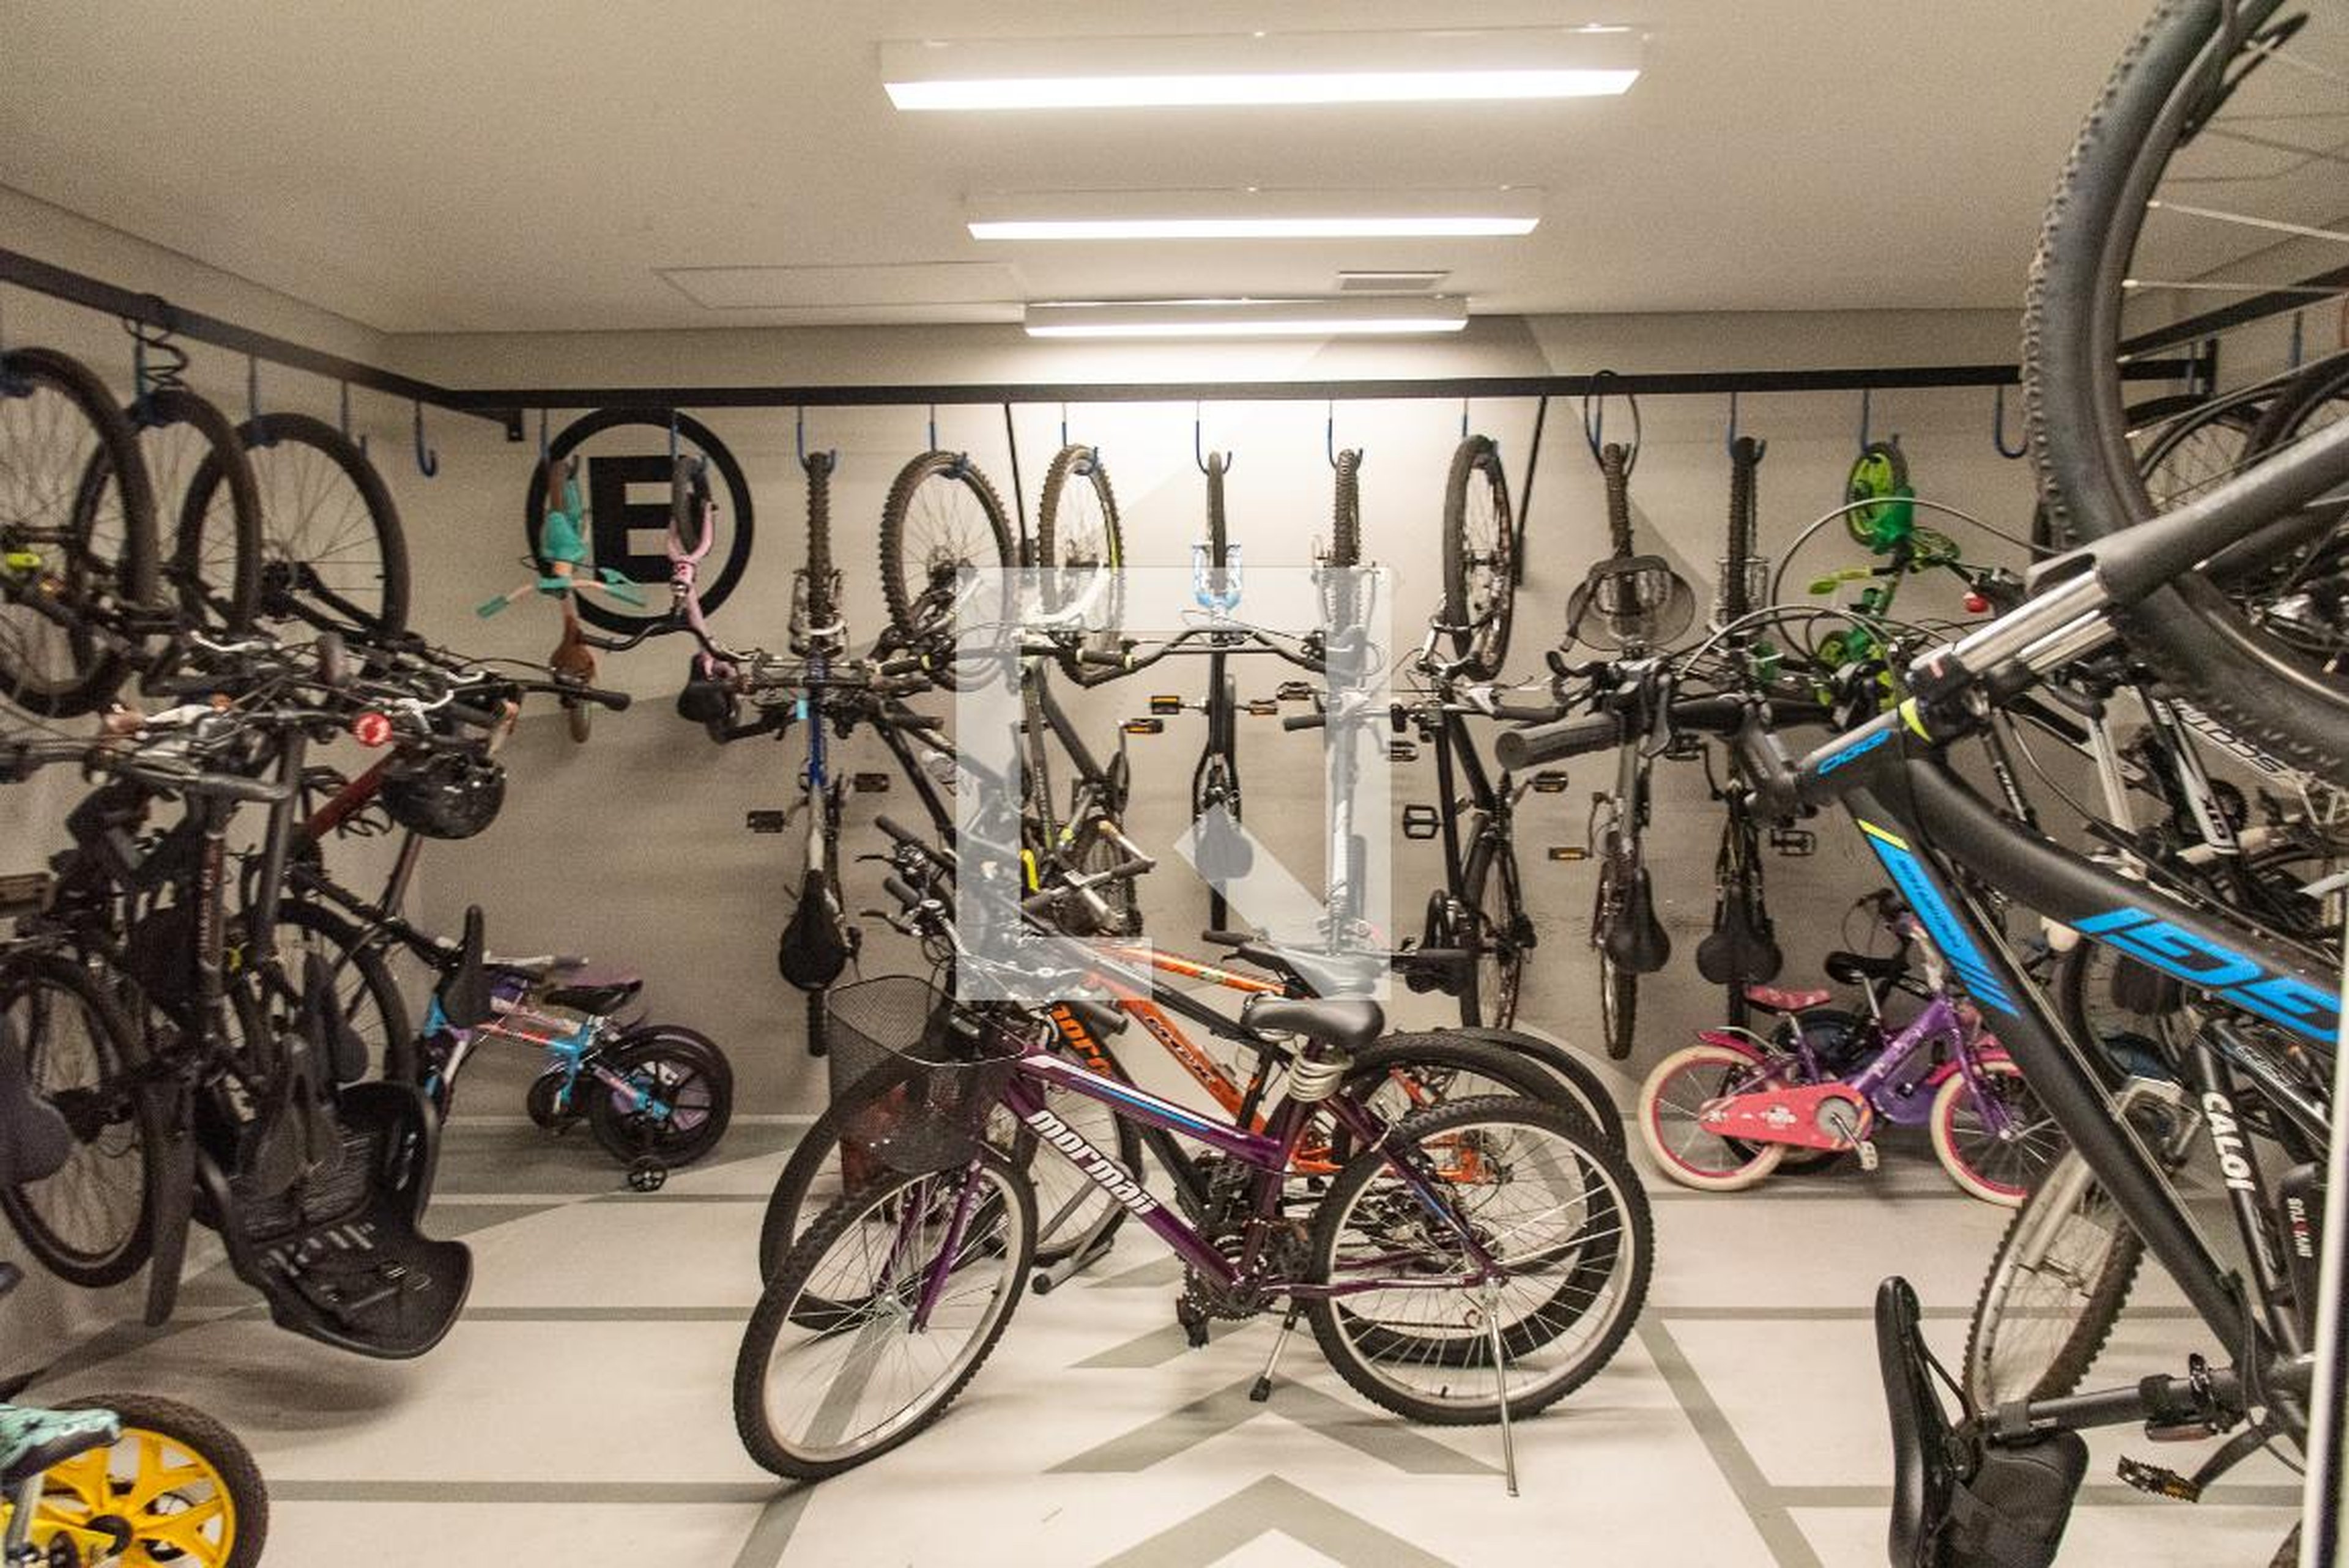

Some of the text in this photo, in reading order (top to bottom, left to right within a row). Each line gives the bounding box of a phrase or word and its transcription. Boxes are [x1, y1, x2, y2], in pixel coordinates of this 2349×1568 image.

[588, 456, 687, 584] E
[1026, 1109, 1158, 1215] mormaii
[2202, 1092, 2255, 1191] CALOI
